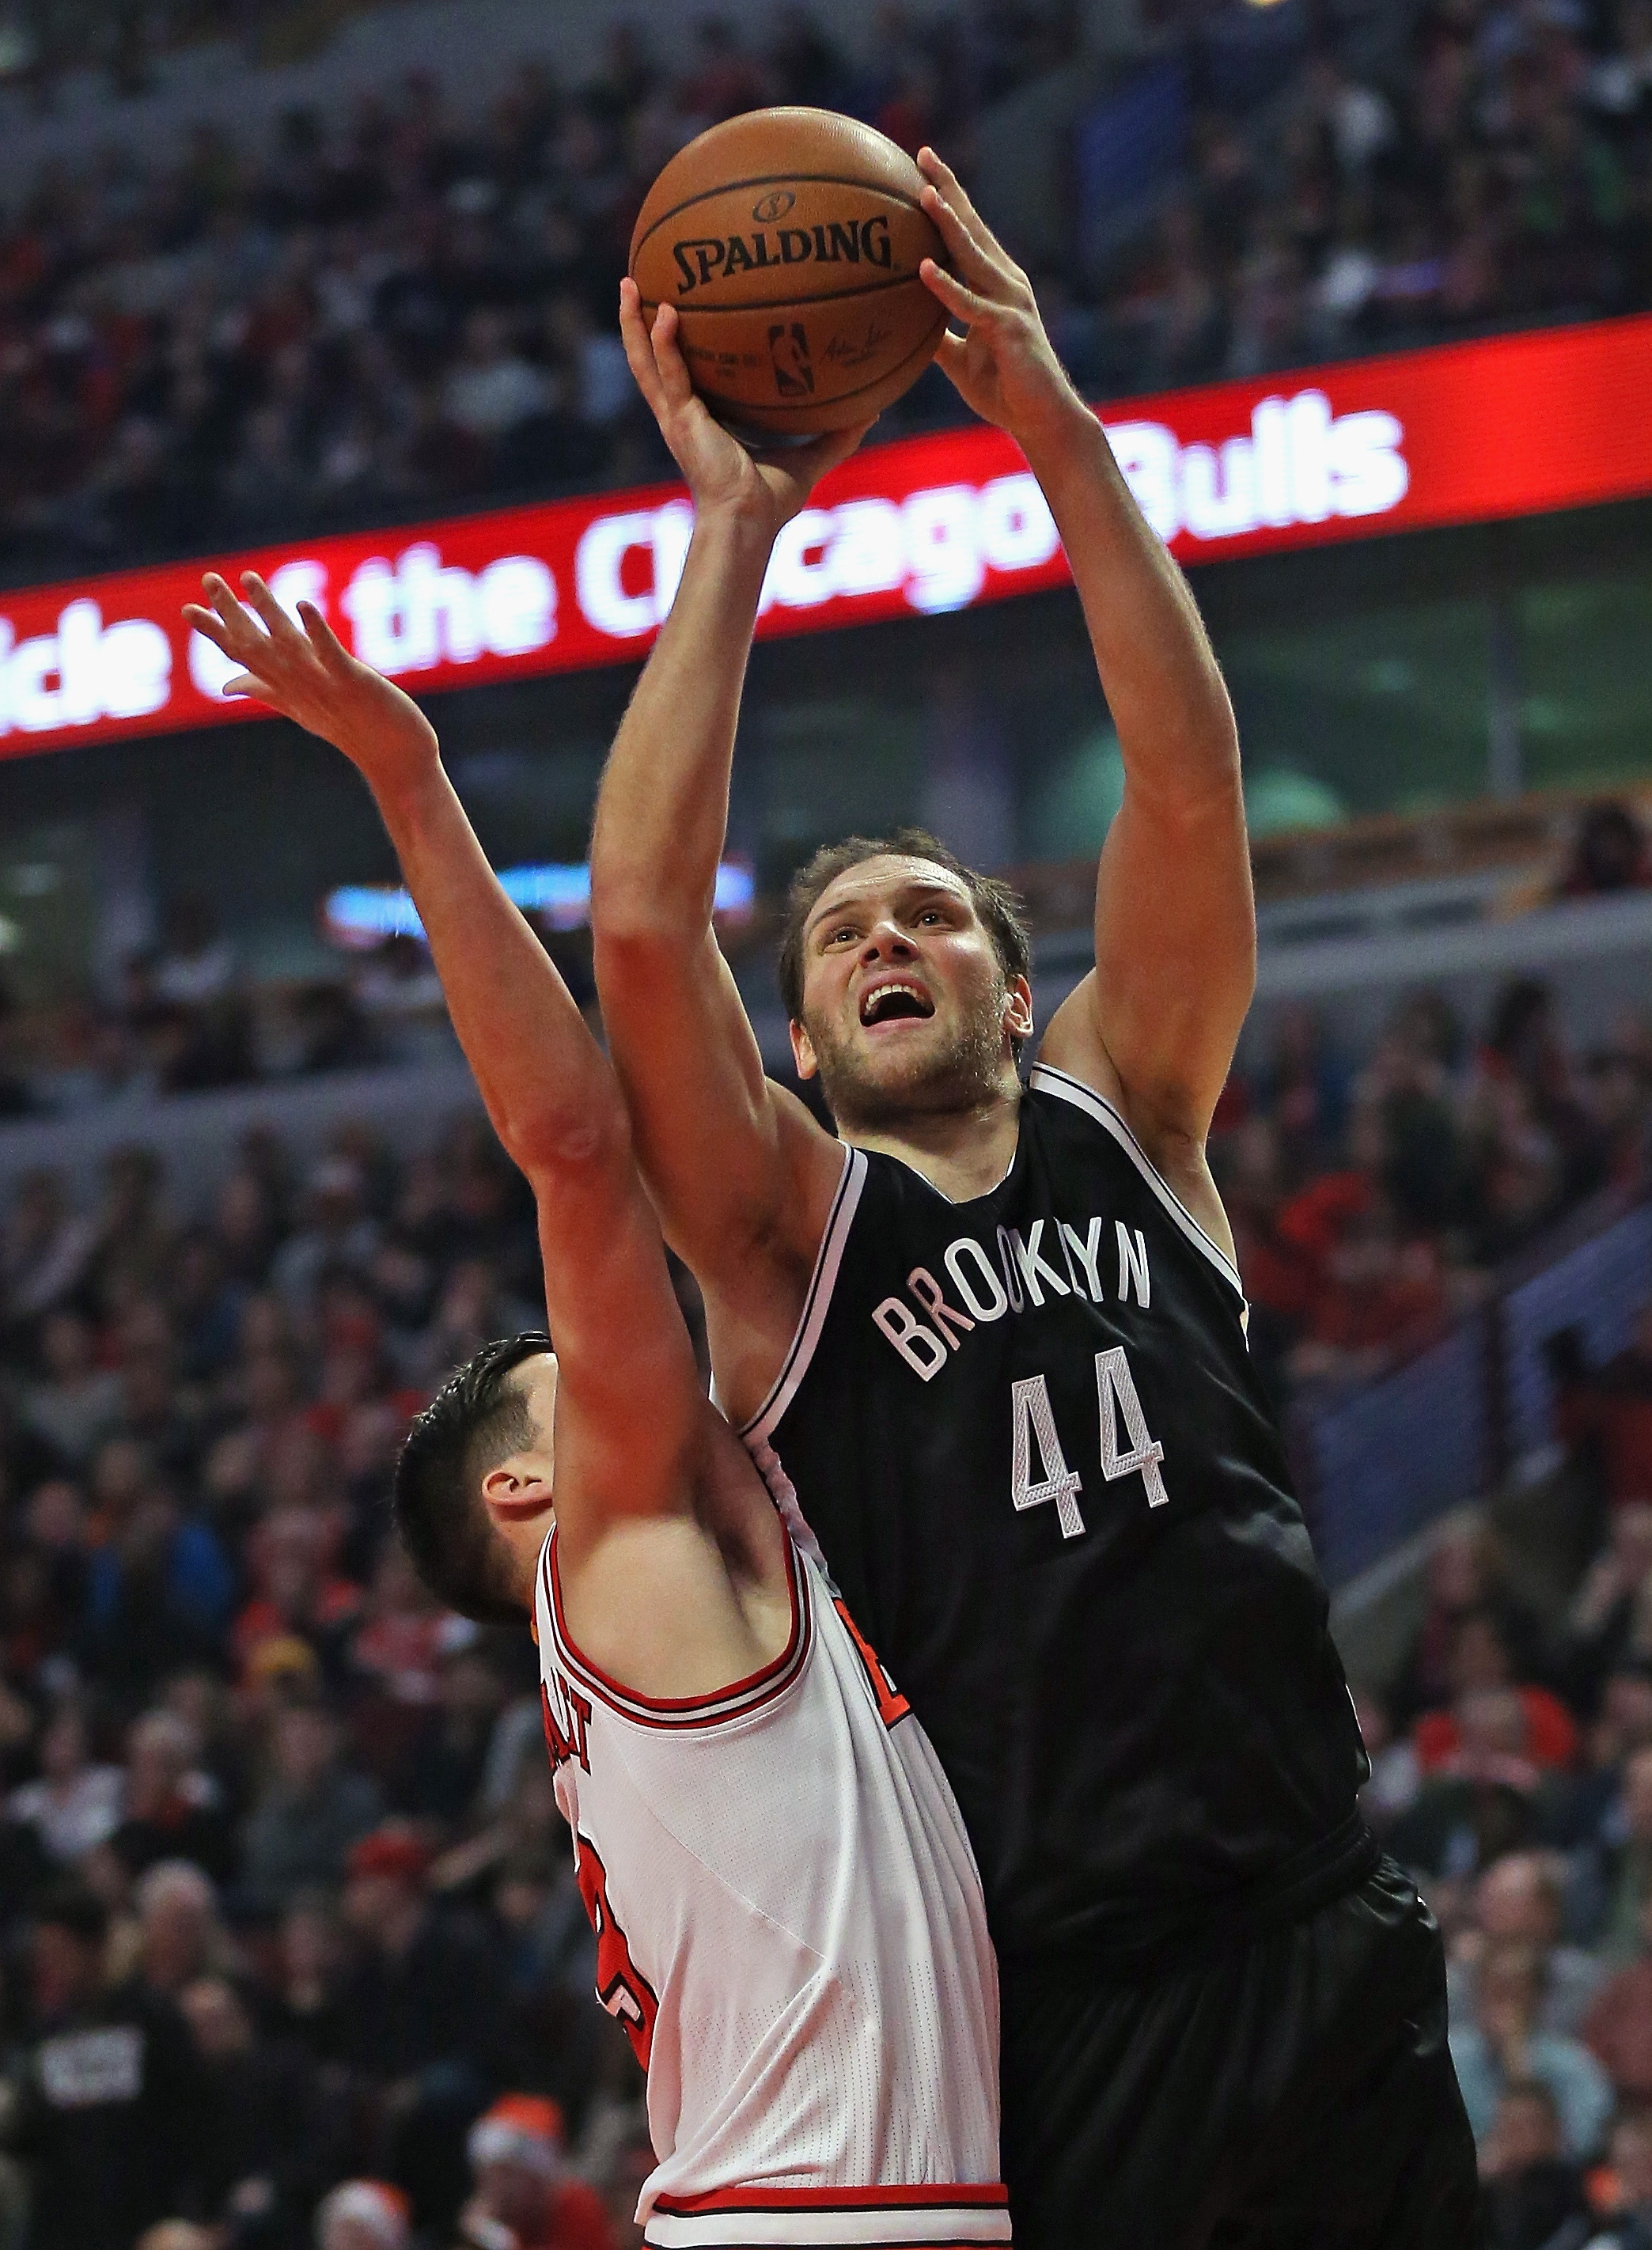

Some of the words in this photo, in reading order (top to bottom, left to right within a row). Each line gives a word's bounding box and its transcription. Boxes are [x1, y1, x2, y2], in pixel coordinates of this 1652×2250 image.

[673, 215, 892, 295] SPALDING
[343, 542, 556, 675] the
[1011, 1346, 1169, 1540] 44
